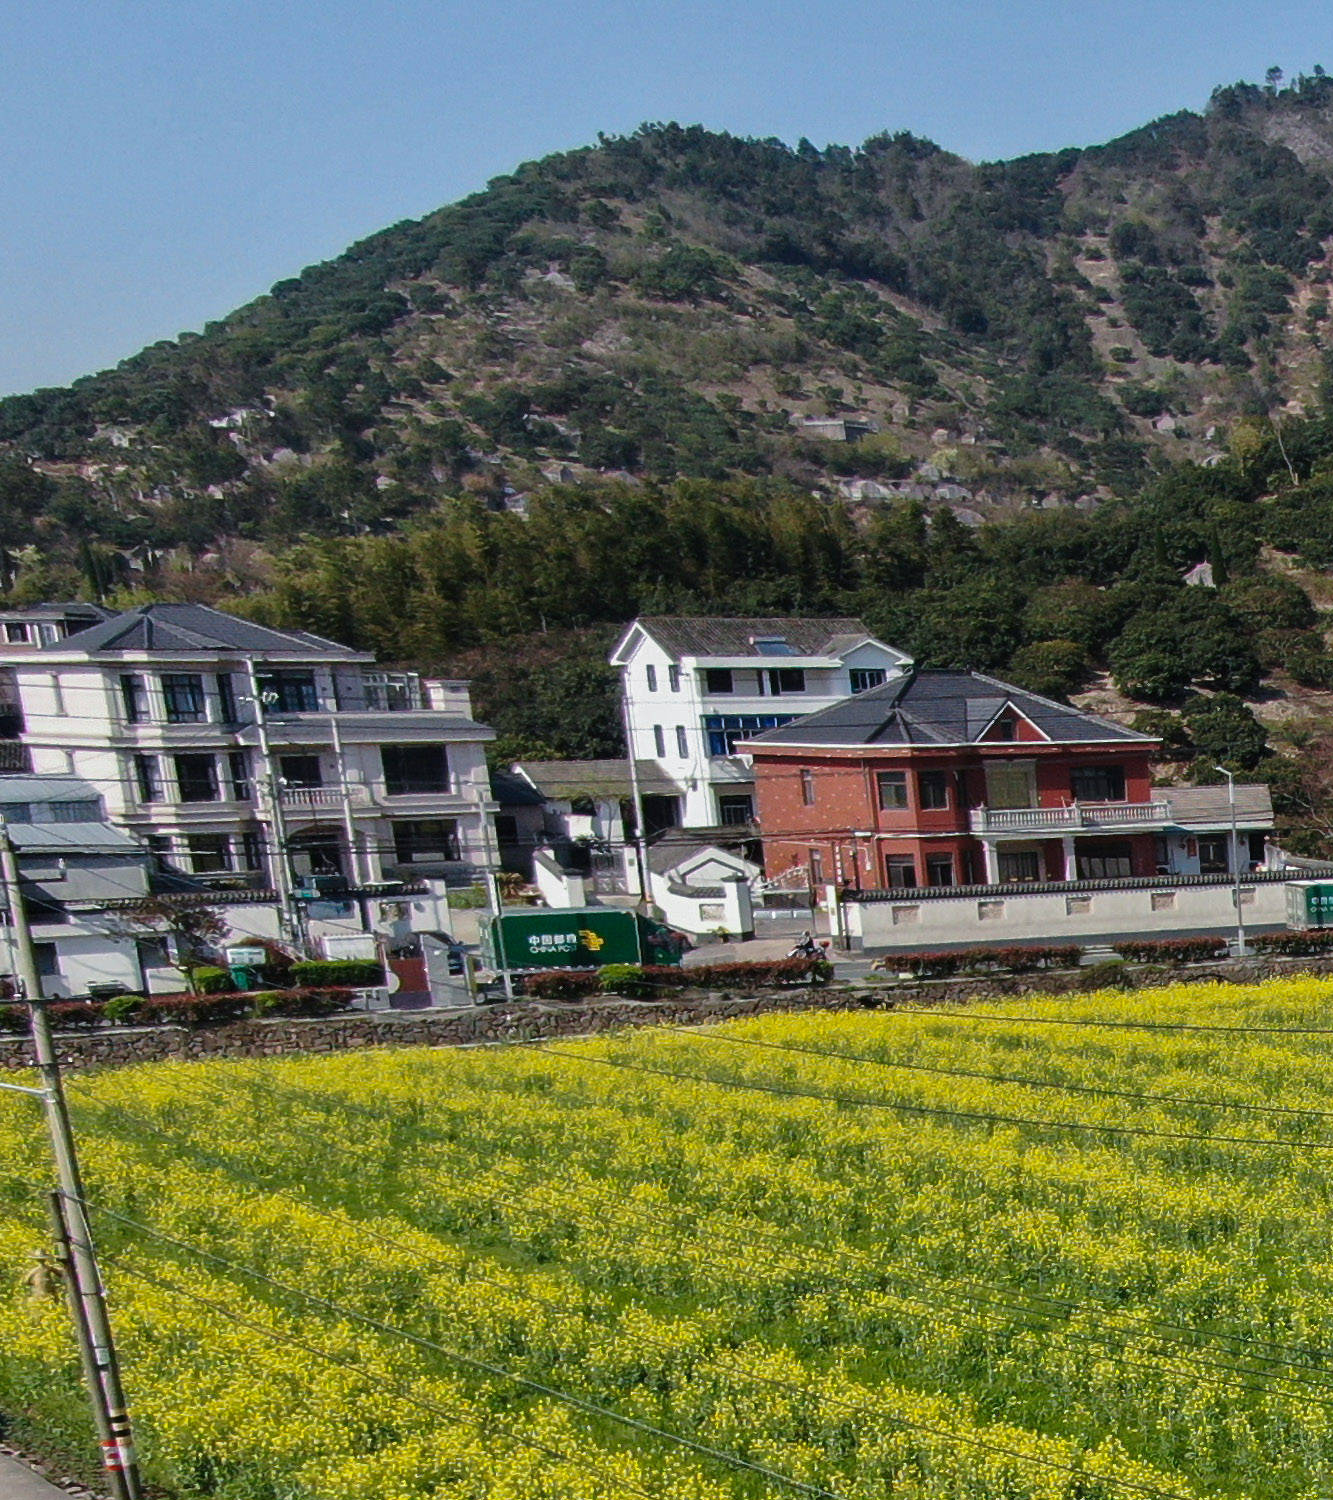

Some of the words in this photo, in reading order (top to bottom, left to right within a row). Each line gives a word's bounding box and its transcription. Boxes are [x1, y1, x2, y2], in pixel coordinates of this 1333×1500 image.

[528, 933, 577, 946] 中国邮政
[529, 945, 557, 954] CHINA
